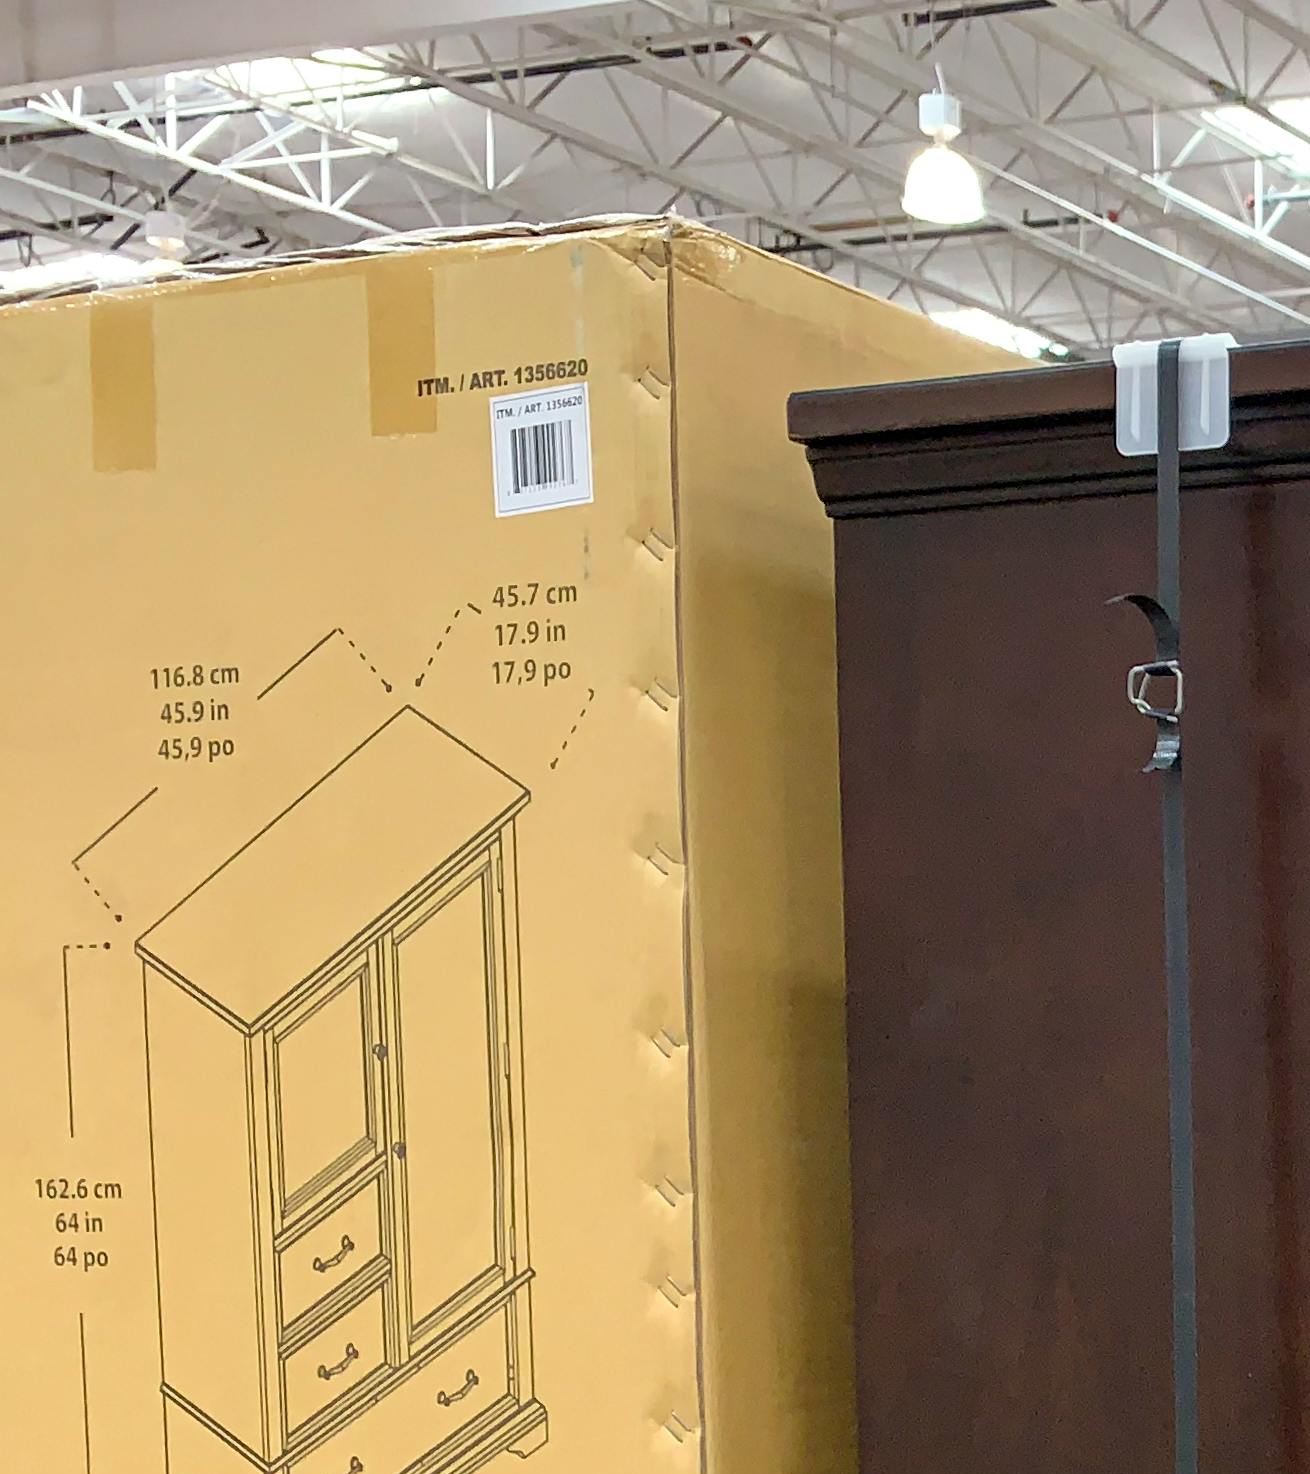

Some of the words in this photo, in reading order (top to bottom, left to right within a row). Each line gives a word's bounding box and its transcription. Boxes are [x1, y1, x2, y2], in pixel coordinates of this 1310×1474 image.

[418, 376, 454, 397] ITM.
[459, 374, 464, 392] /
[469, 370, 508, 390] ART.
[514, 358, 588, 384] 1356620
[496, 408, 515, 419] ITM.
[524, 402, 543, 415] ART.
[546, 395, 582, 411] 1356620
[492, 583, 539, 608] 45.7
[546, 585, 577, 604] cm
[495, 621, 539, 646] 17.9
[546, 618, 565, 642] in
[150, 664, 204, 689] 116.8
[210, 667, 239, 684] cm
[492, 659, 536, 685] 17,9
[544, 662, 571, 687] po
[160, 701, 204, 723] 45.9
[210, 698, 229, 720] in
[158, 736, 202, 762] 45,9
[208, 739, 234, 762] po
[34, 1178, 88, 1199] 162.6
[94, 1182, 122, 1199] cm
[55, 1212, 79, 1233] 64
[85, 1211, 103, 1232] in
[54, 1246, 77, 1266] 64
[84, 1250, 109, 1272] po
